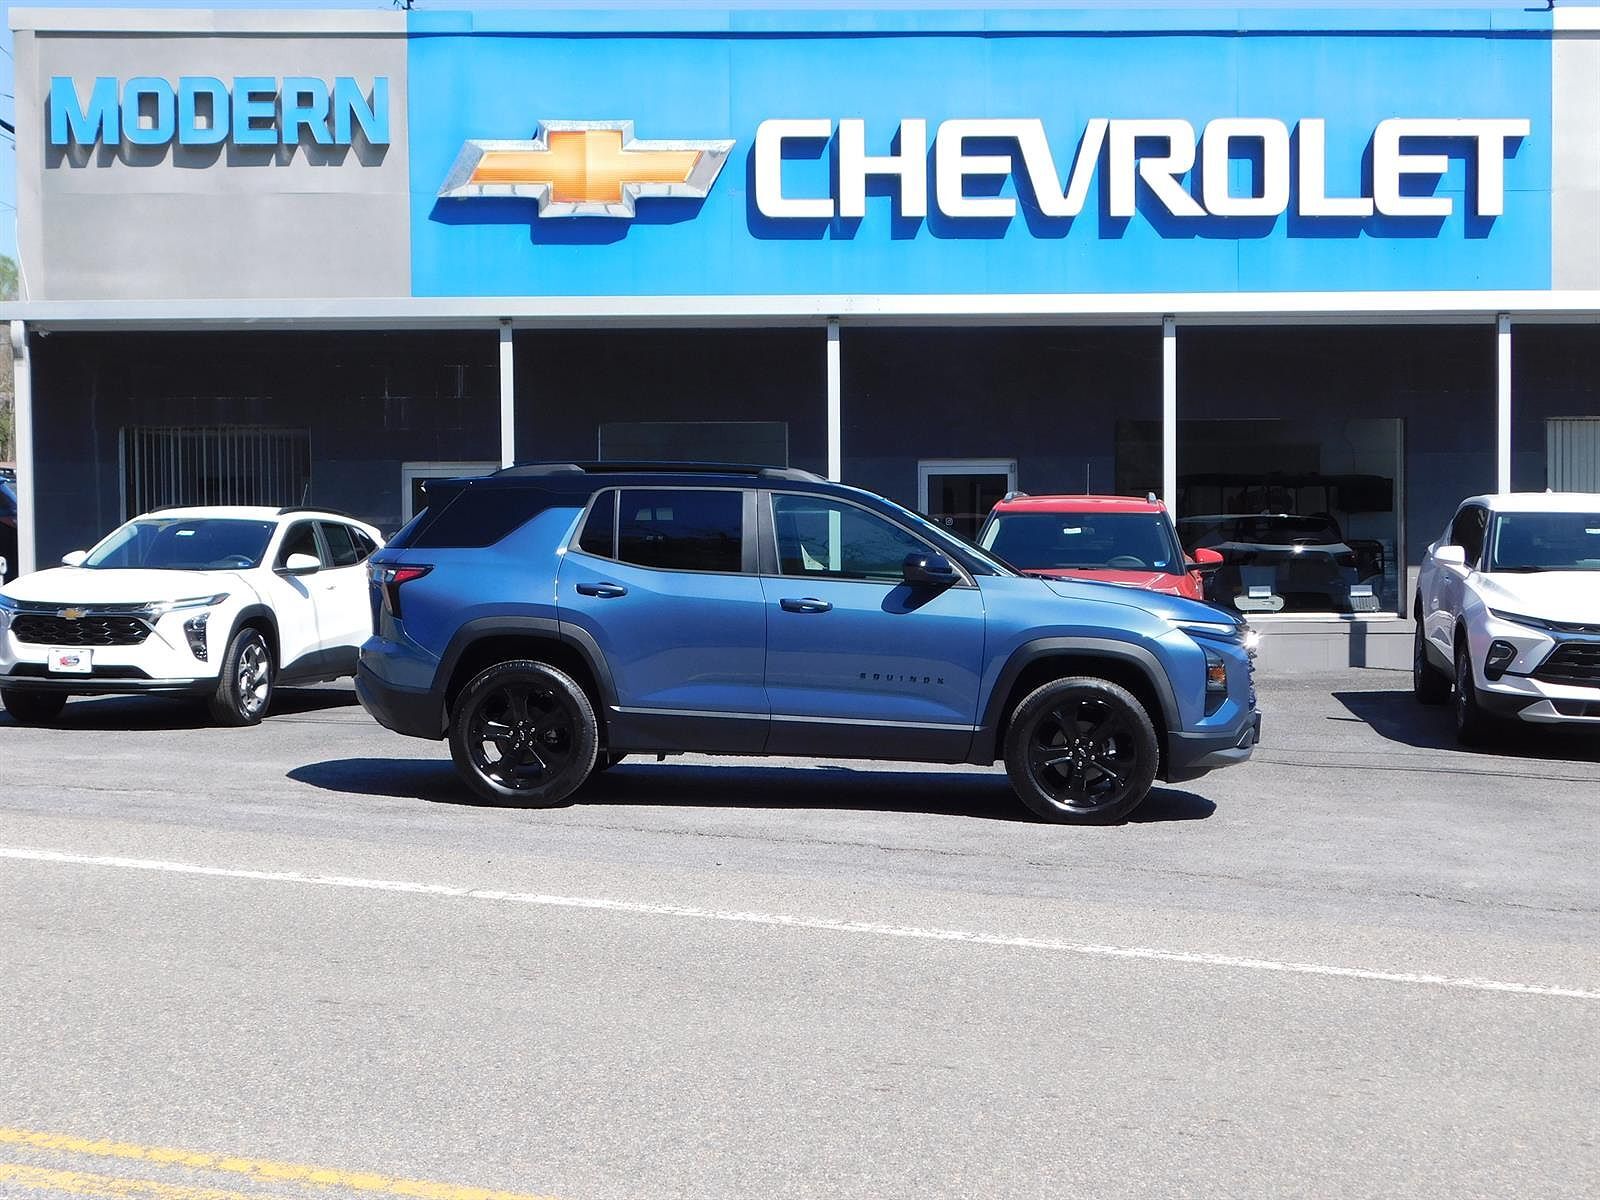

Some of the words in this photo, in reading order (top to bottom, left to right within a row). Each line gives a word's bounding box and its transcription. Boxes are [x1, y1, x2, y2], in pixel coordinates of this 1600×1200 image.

[50, 76, 390, 144] MODERN
[755, 118, 1531, 218] CHEVROLET
[859, 672, 945, 685] EQUINOX
